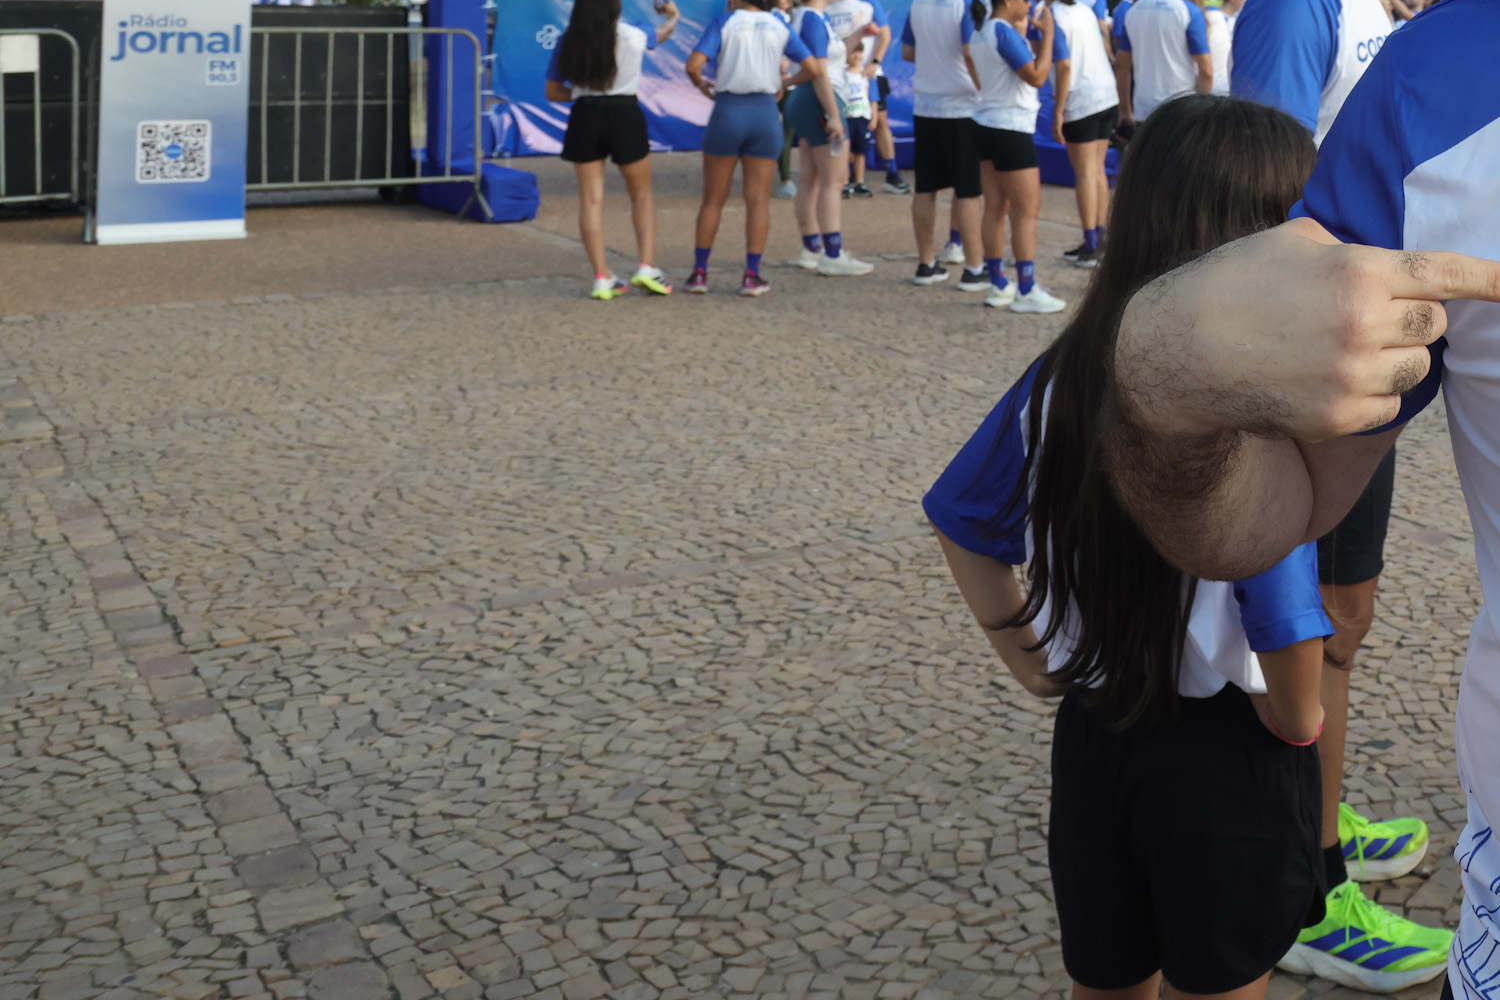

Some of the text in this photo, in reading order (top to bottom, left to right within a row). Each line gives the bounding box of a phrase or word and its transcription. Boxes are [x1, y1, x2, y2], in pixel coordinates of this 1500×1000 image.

[130, 14, 188, 28] Rádio
[110, 21, 242, 61] jornal
[209, 60, 236, 71] FM
